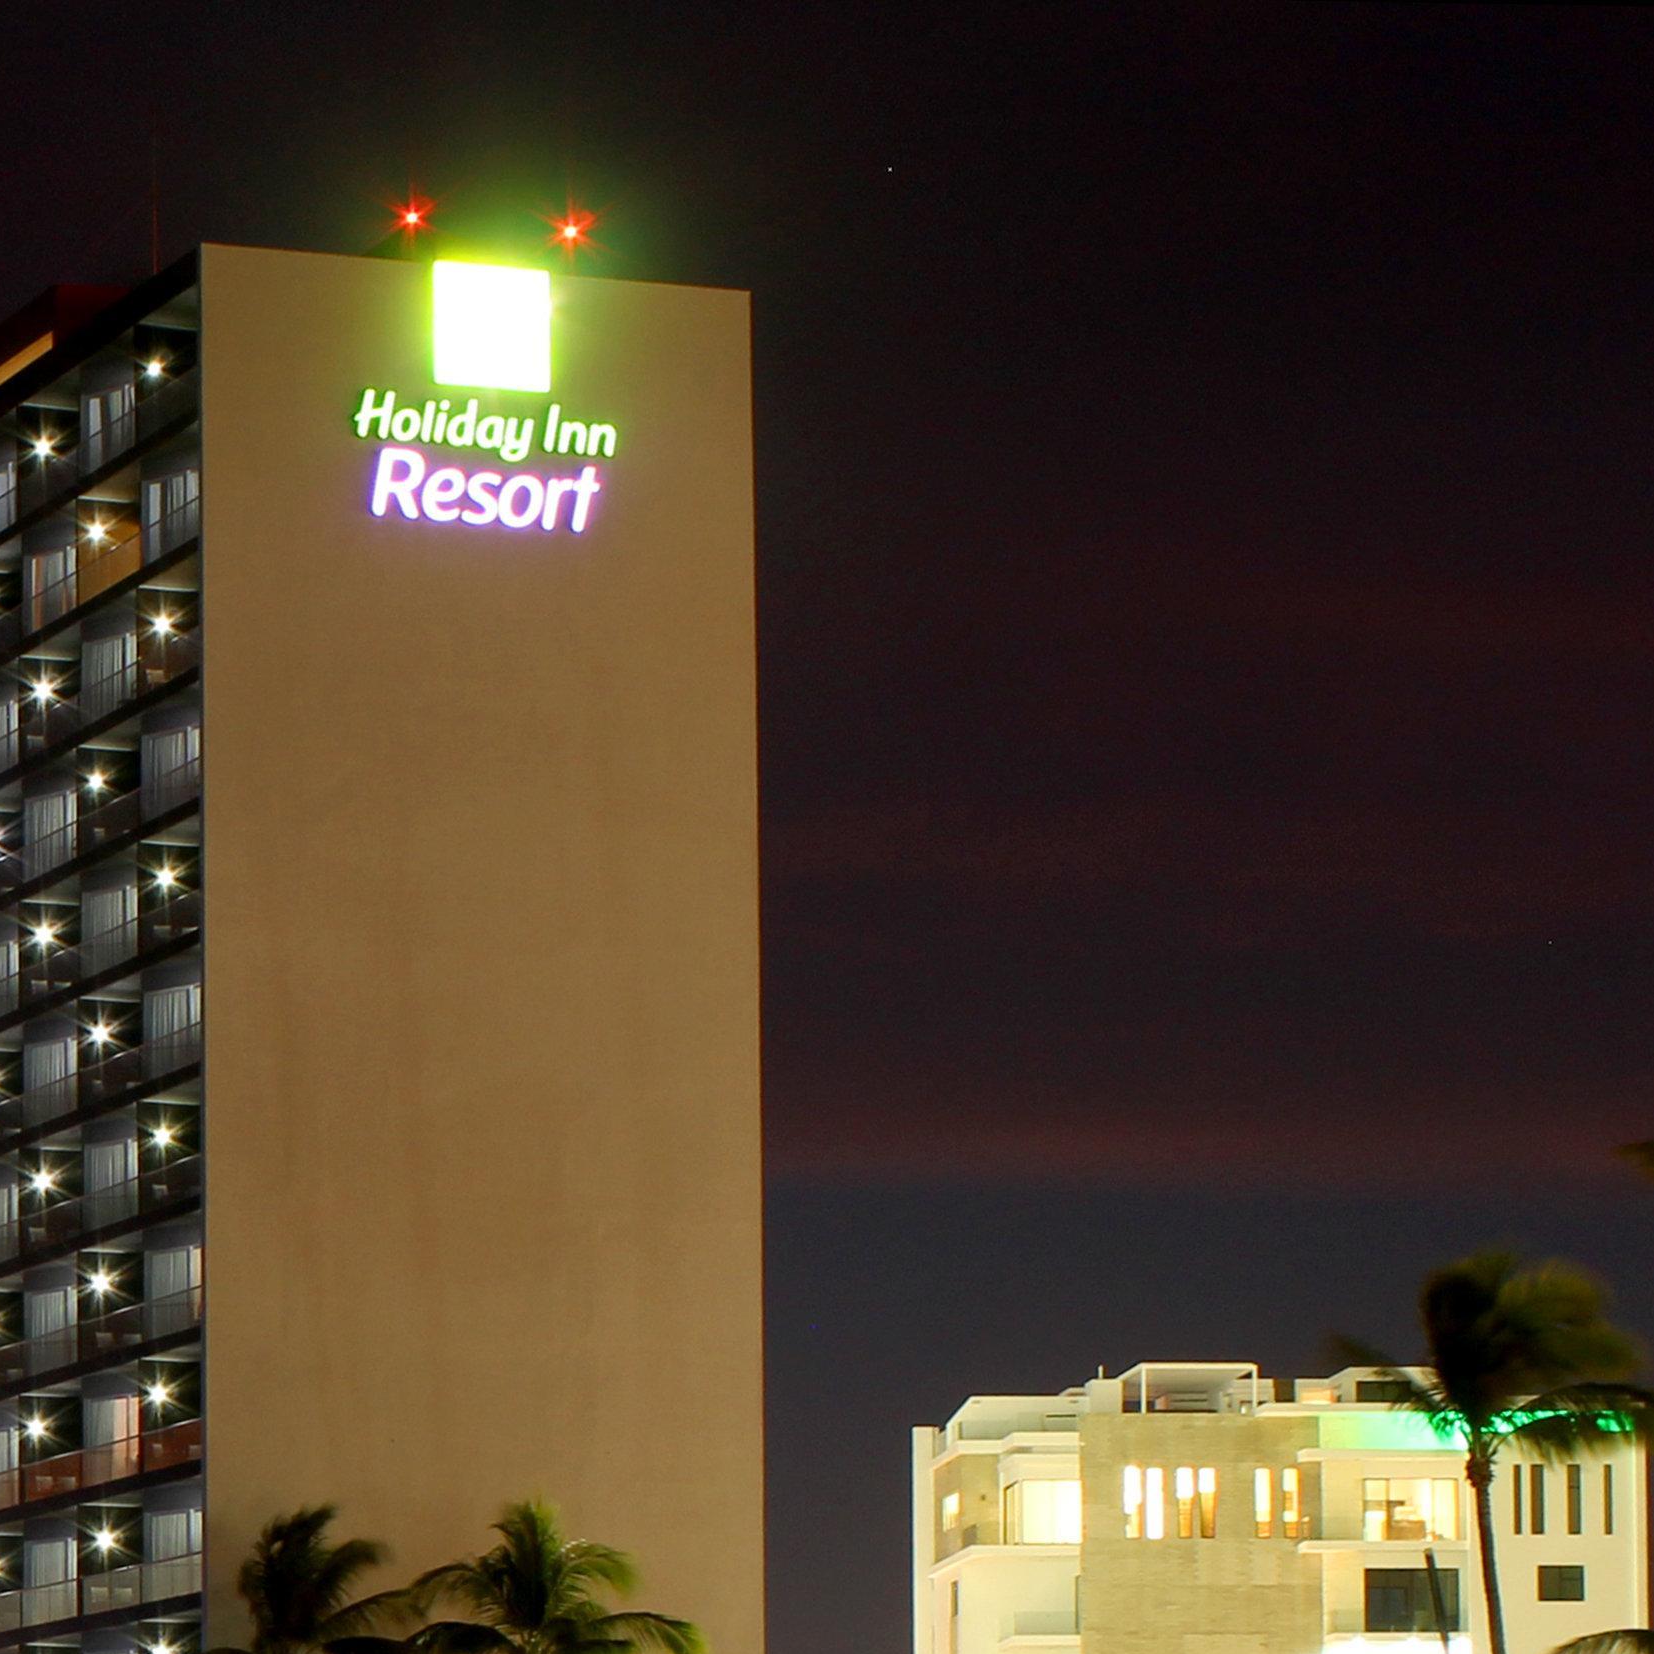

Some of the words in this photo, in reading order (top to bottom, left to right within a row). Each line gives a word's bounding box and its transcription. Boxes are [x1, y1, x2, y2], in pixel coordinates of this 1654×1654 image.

[354, 388, 534, 462] Holiday
[543, 404, 616, 457] Inn
[370, 447, 600, 532] Resort
